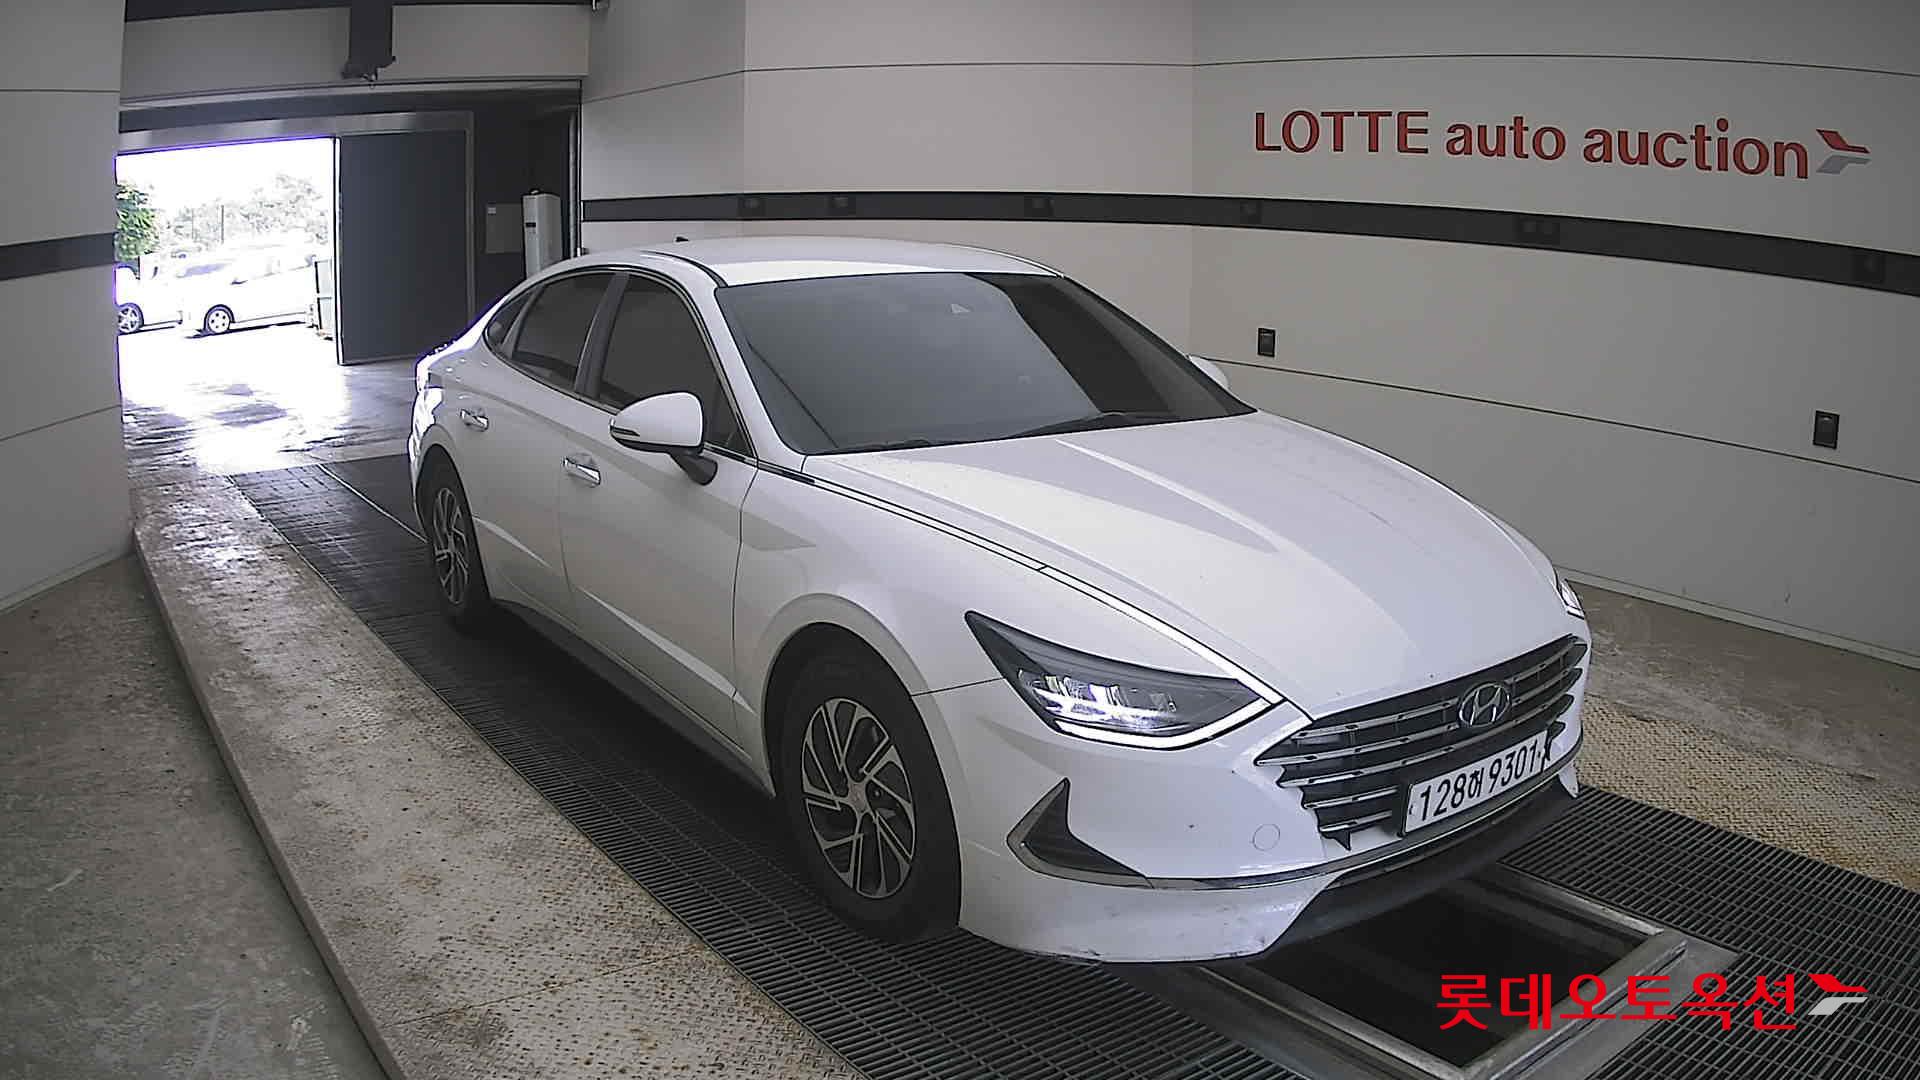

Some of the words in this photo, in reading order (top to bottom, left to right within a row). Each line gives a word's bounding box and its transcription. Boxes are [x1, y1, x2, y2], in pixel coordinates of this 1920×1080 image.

[1255, 110, 1430, 152] LOTTE
[1446, 115, 1567, 160] auto
[1583, 117, 1808, 179] auction
